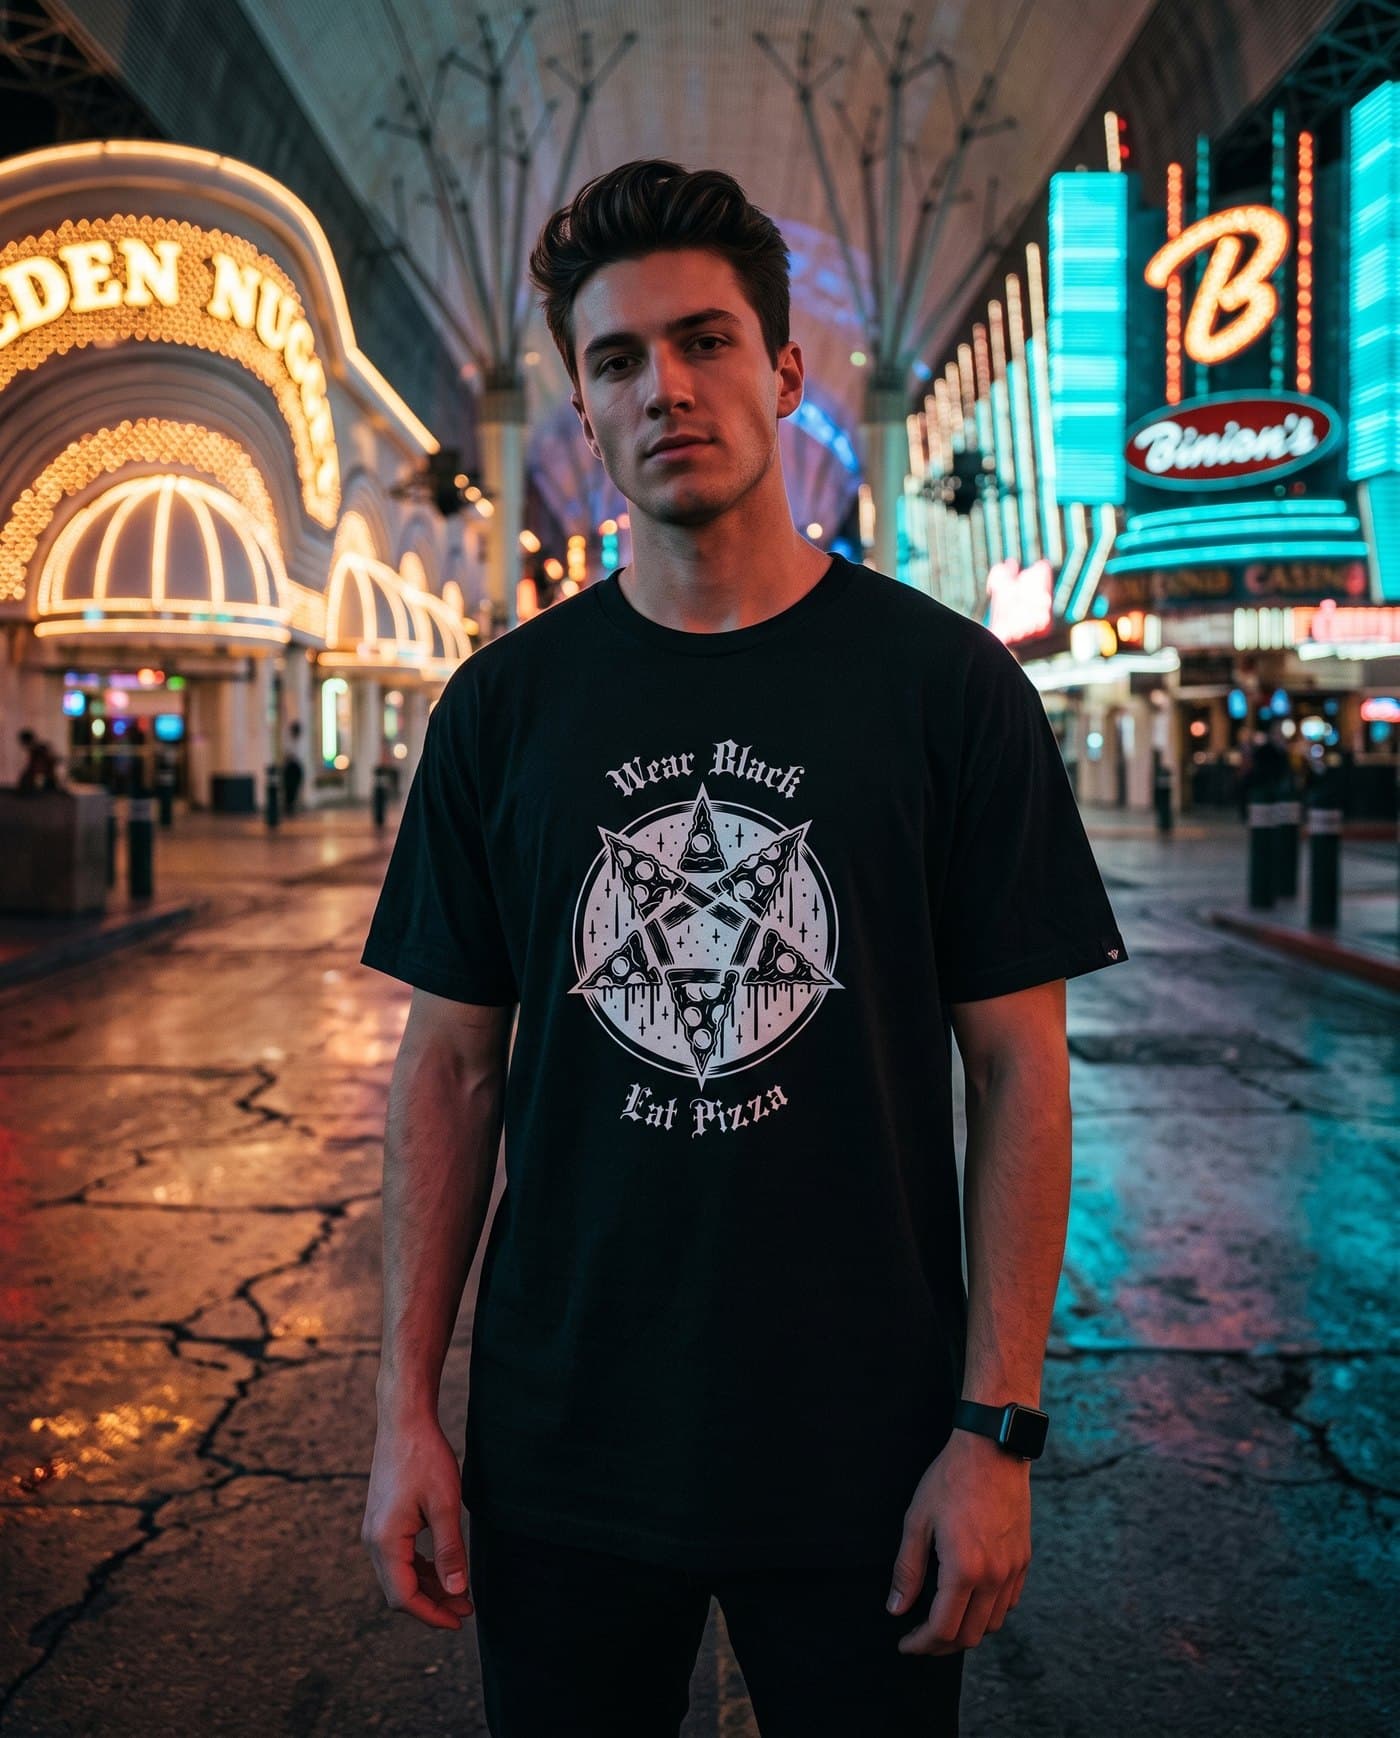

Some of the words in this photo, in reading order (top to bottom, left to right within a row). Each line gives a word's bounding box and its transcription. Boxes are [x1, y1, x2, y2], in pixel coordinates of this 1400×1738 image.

[1145, 205, 1290, 365] B
[1134, 413, 1319, 474] Binion's
[605, 752, 695, 797] Wear
[708, 739, 805, 798] Black
[620, 1083, 678, 1130] Eat
[690, 1085, 788, 1138] Pizza
